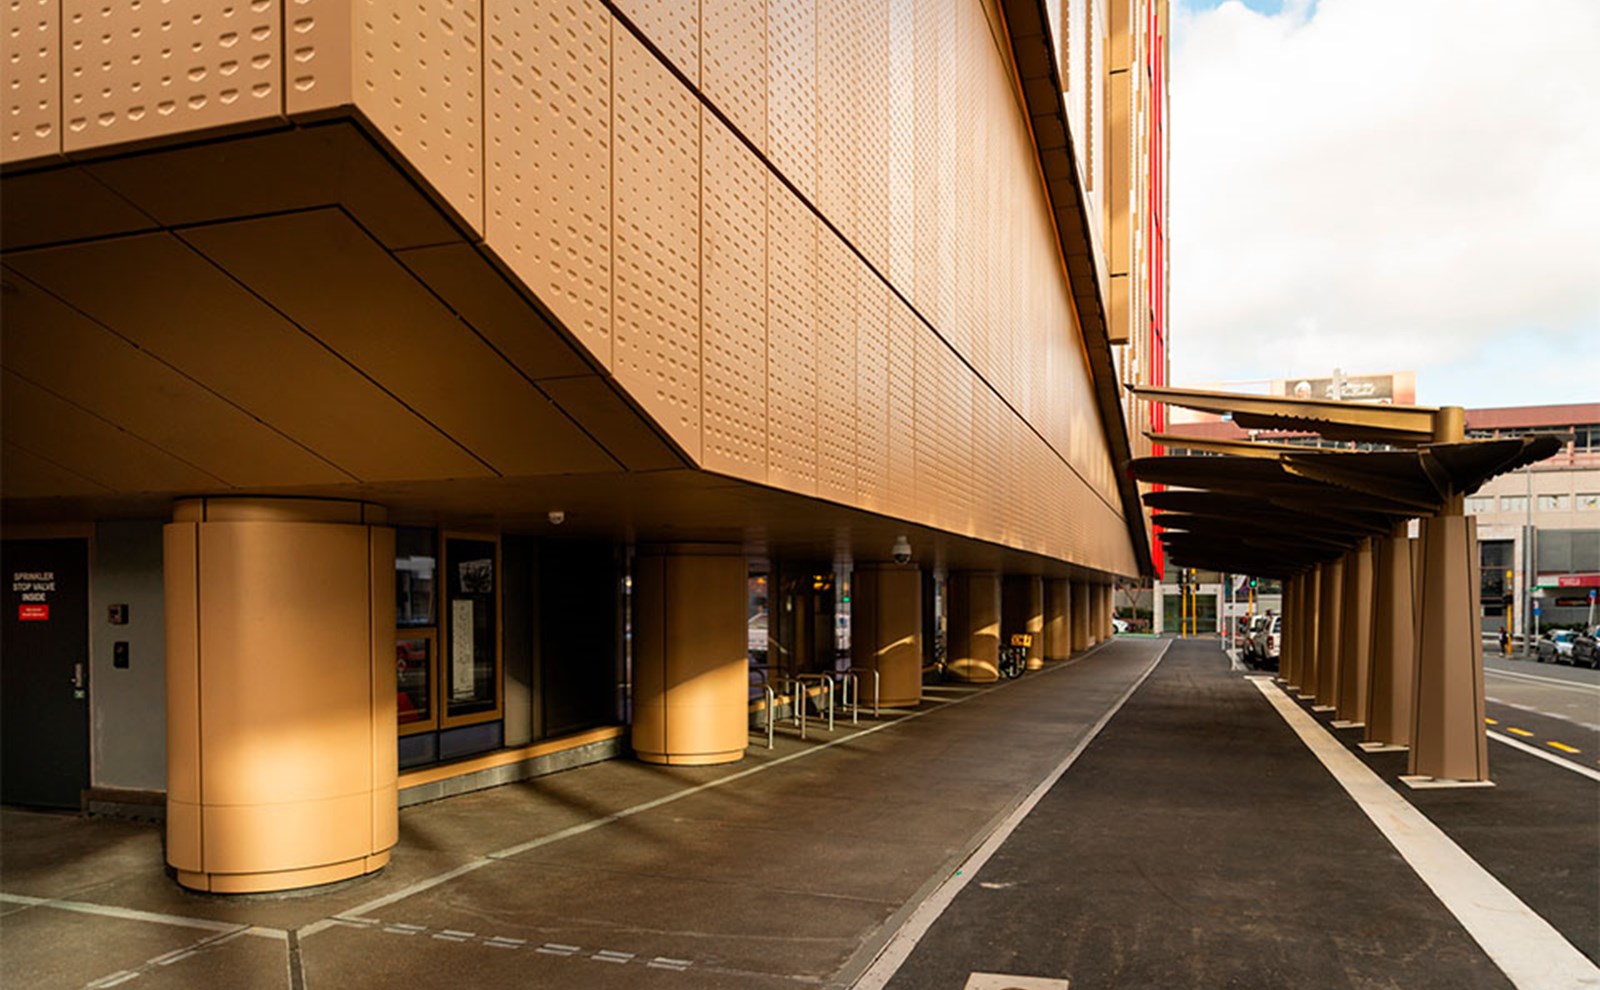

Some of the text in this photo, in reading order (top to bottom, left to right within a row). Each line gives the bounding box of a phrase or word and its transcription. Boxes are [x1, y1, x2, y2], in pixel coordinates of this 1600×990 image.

[13, 572, 54, 581] SPRINKLER
[13, 582, 56, 591] STOP VALVE
[22, 592, 46, 602] INSIDE
